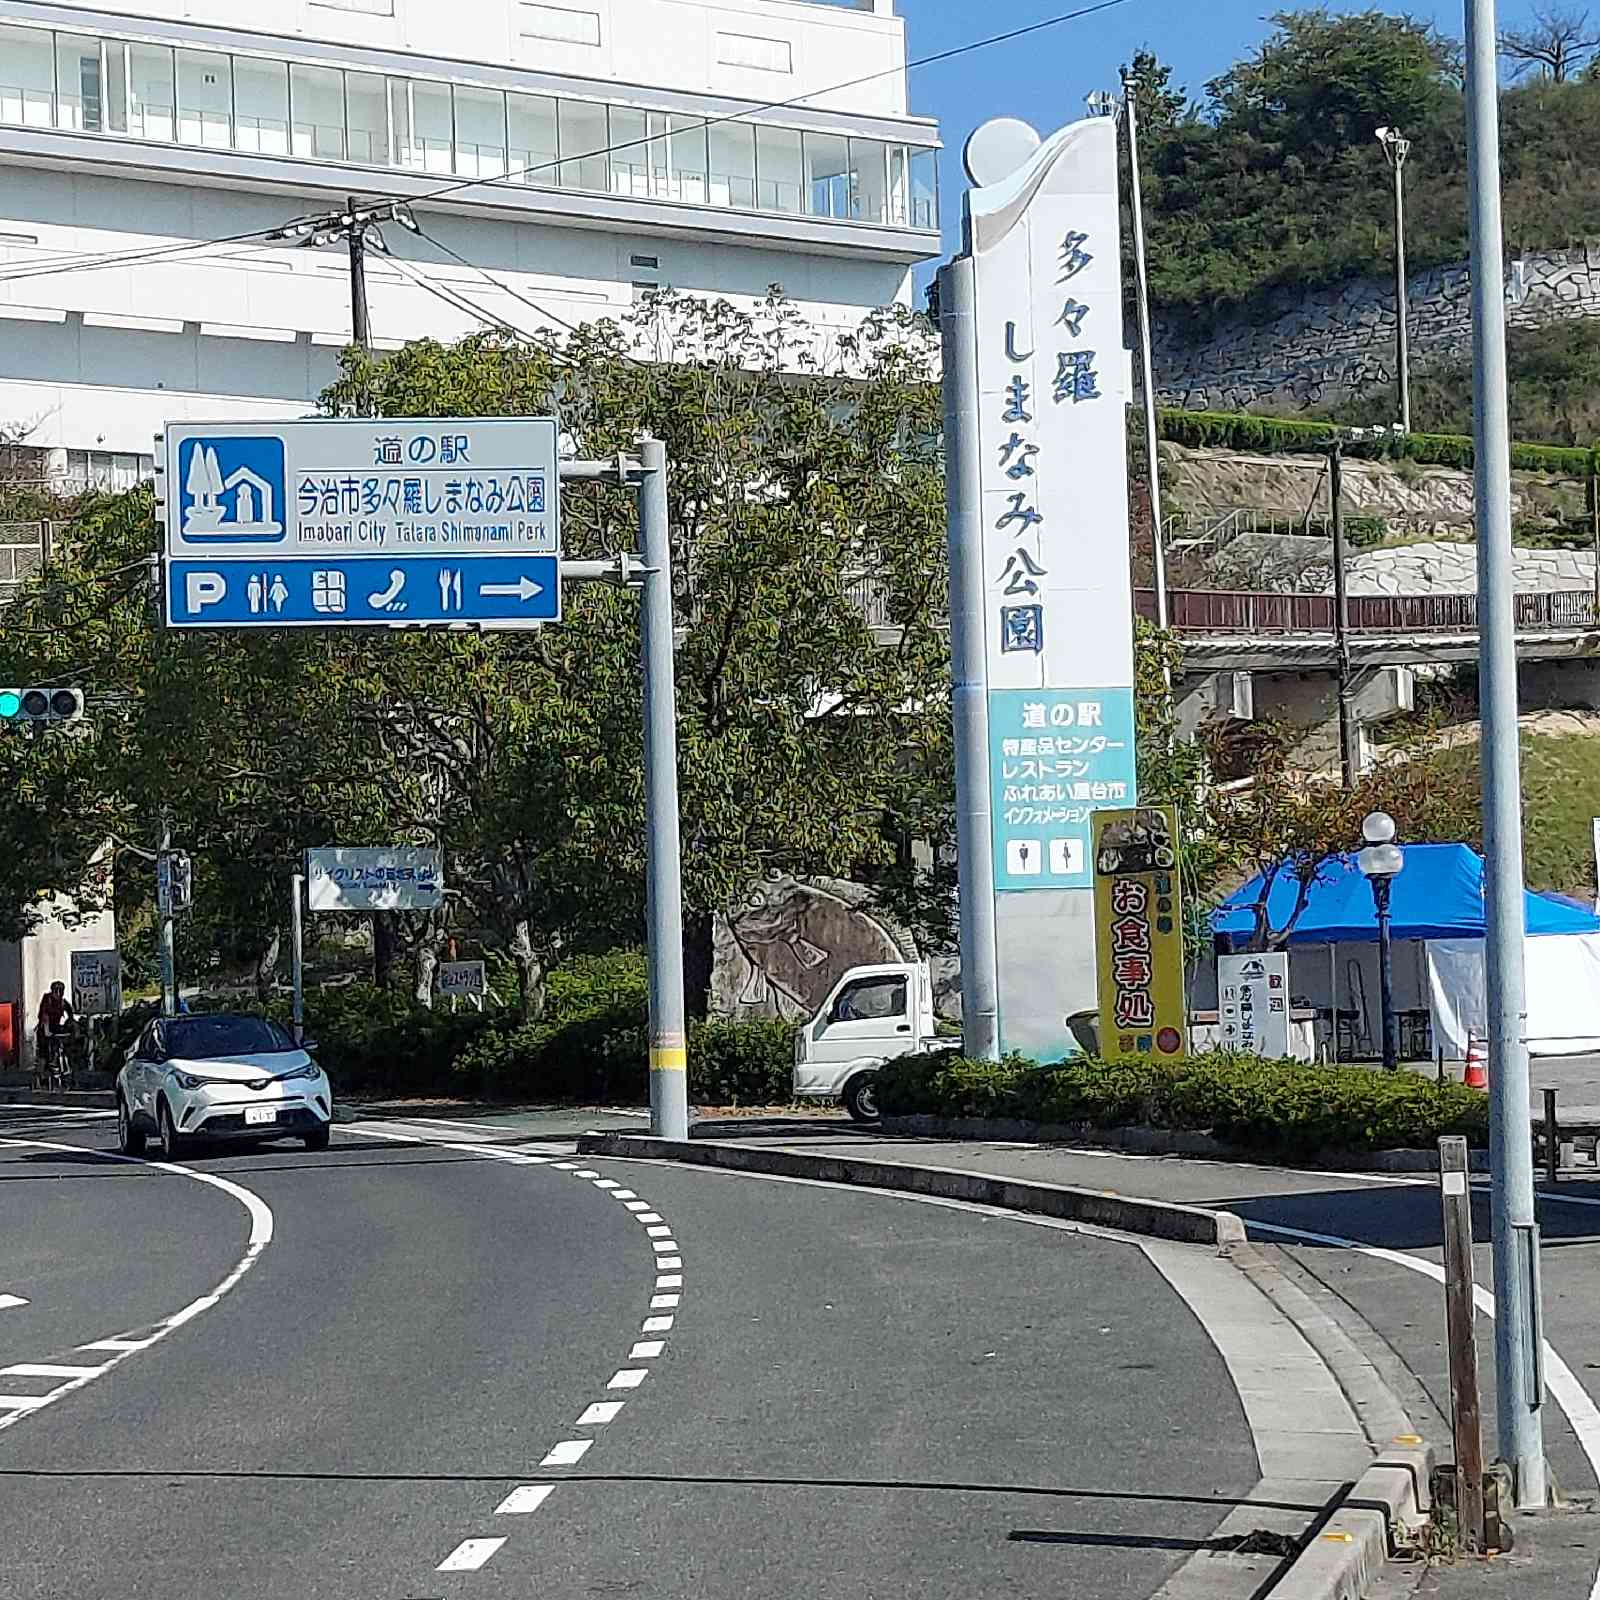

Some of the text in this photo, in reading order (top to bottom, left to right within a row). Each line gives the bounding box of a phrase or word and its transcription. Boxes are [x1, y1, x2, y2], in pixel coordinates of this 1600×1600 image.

[1054, 229, 1101, 406] 多々羅
[374, 434, 471, 465] 道の駅
[297, 475, 546, 516] 今治市多々羅しまなみ公園
[994, 320, 1047, 656] しまなみ公園
[298, 519, 546, 546] Imabari City Tatara Shimanami Park
[1022, 702, 1103, 729] 道の駅
[1002, 735, 1125, 757] 特産品センター
[1002, 758, 1090, 779] レストラン
[1003, 782, 1127, 802] ふれあい屋台市
[1113, 878, 1155, 1029] お食事処
